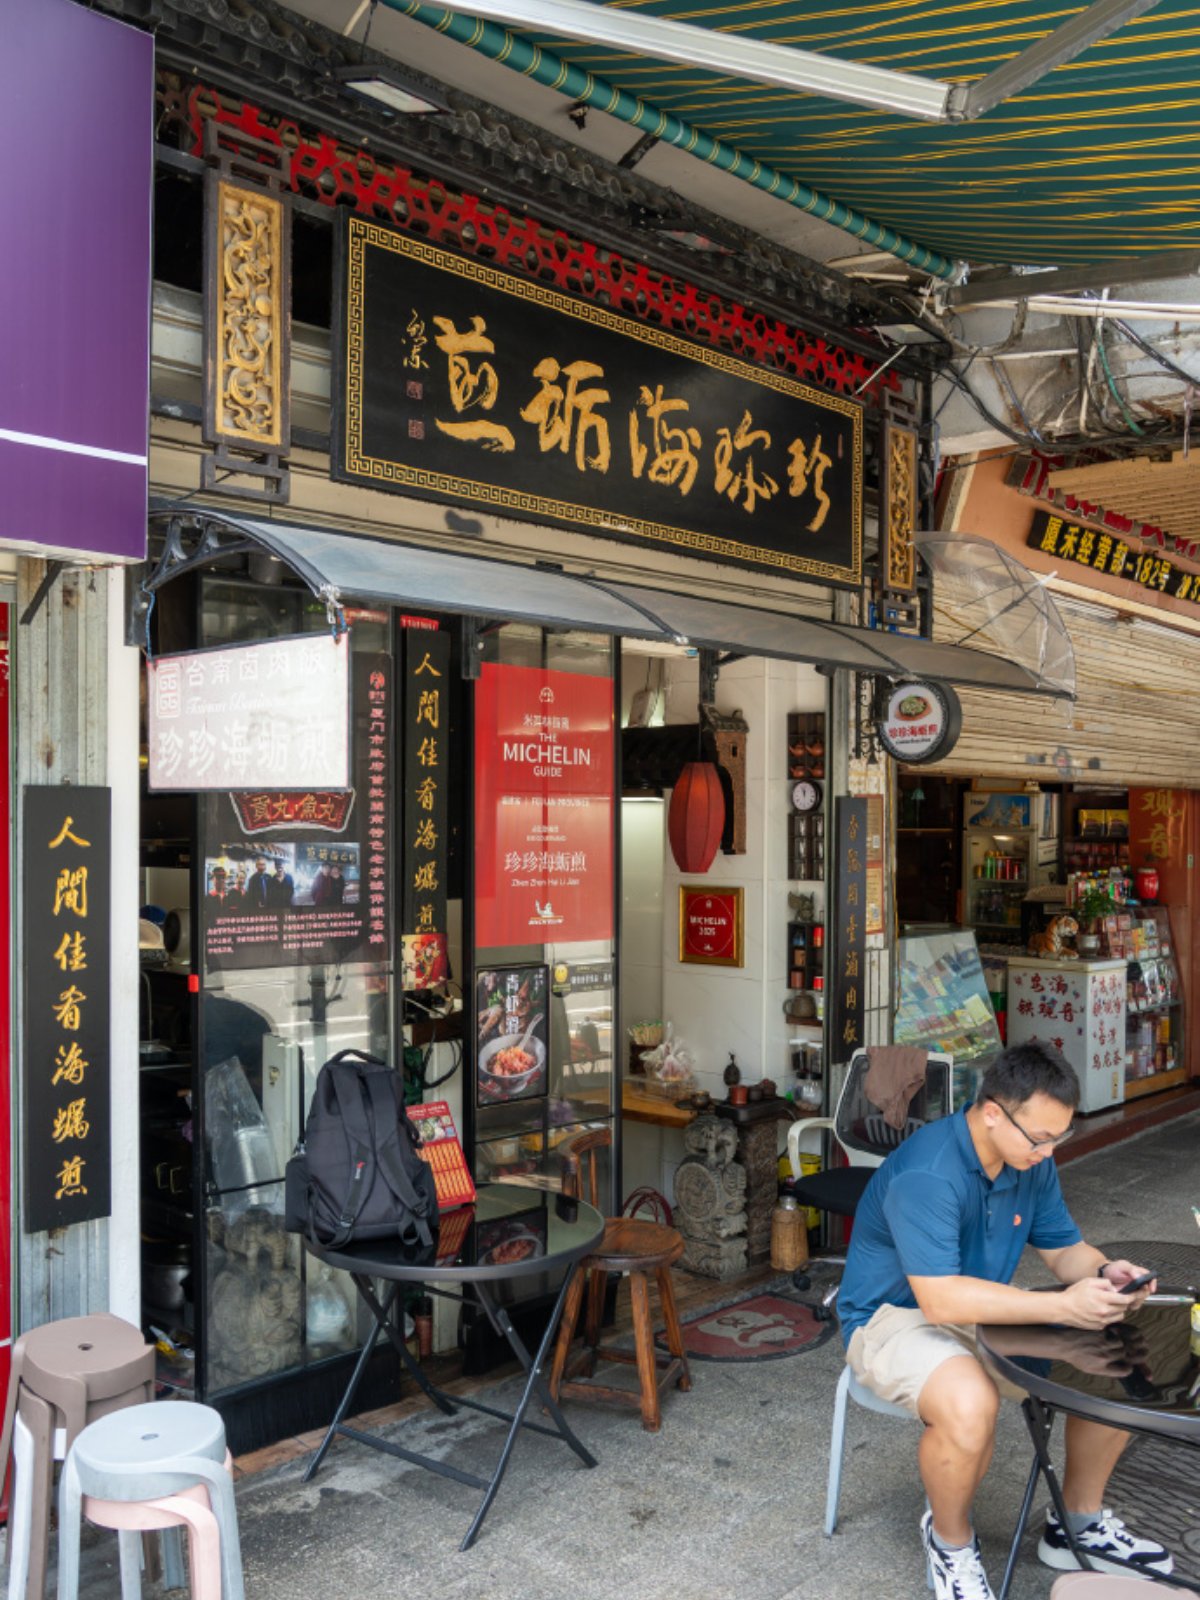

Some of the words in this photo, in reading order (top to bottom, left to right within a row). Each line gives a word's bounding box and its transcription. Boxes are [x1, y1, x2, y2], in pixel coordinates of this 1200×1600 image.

[539, 732, 557, 743] THE
[503, 742, 591, 766] MICHELIN
[533, 766, 563, 777] GUIDE
[504, 851, 587, 873] 珍珍海蛎煎
